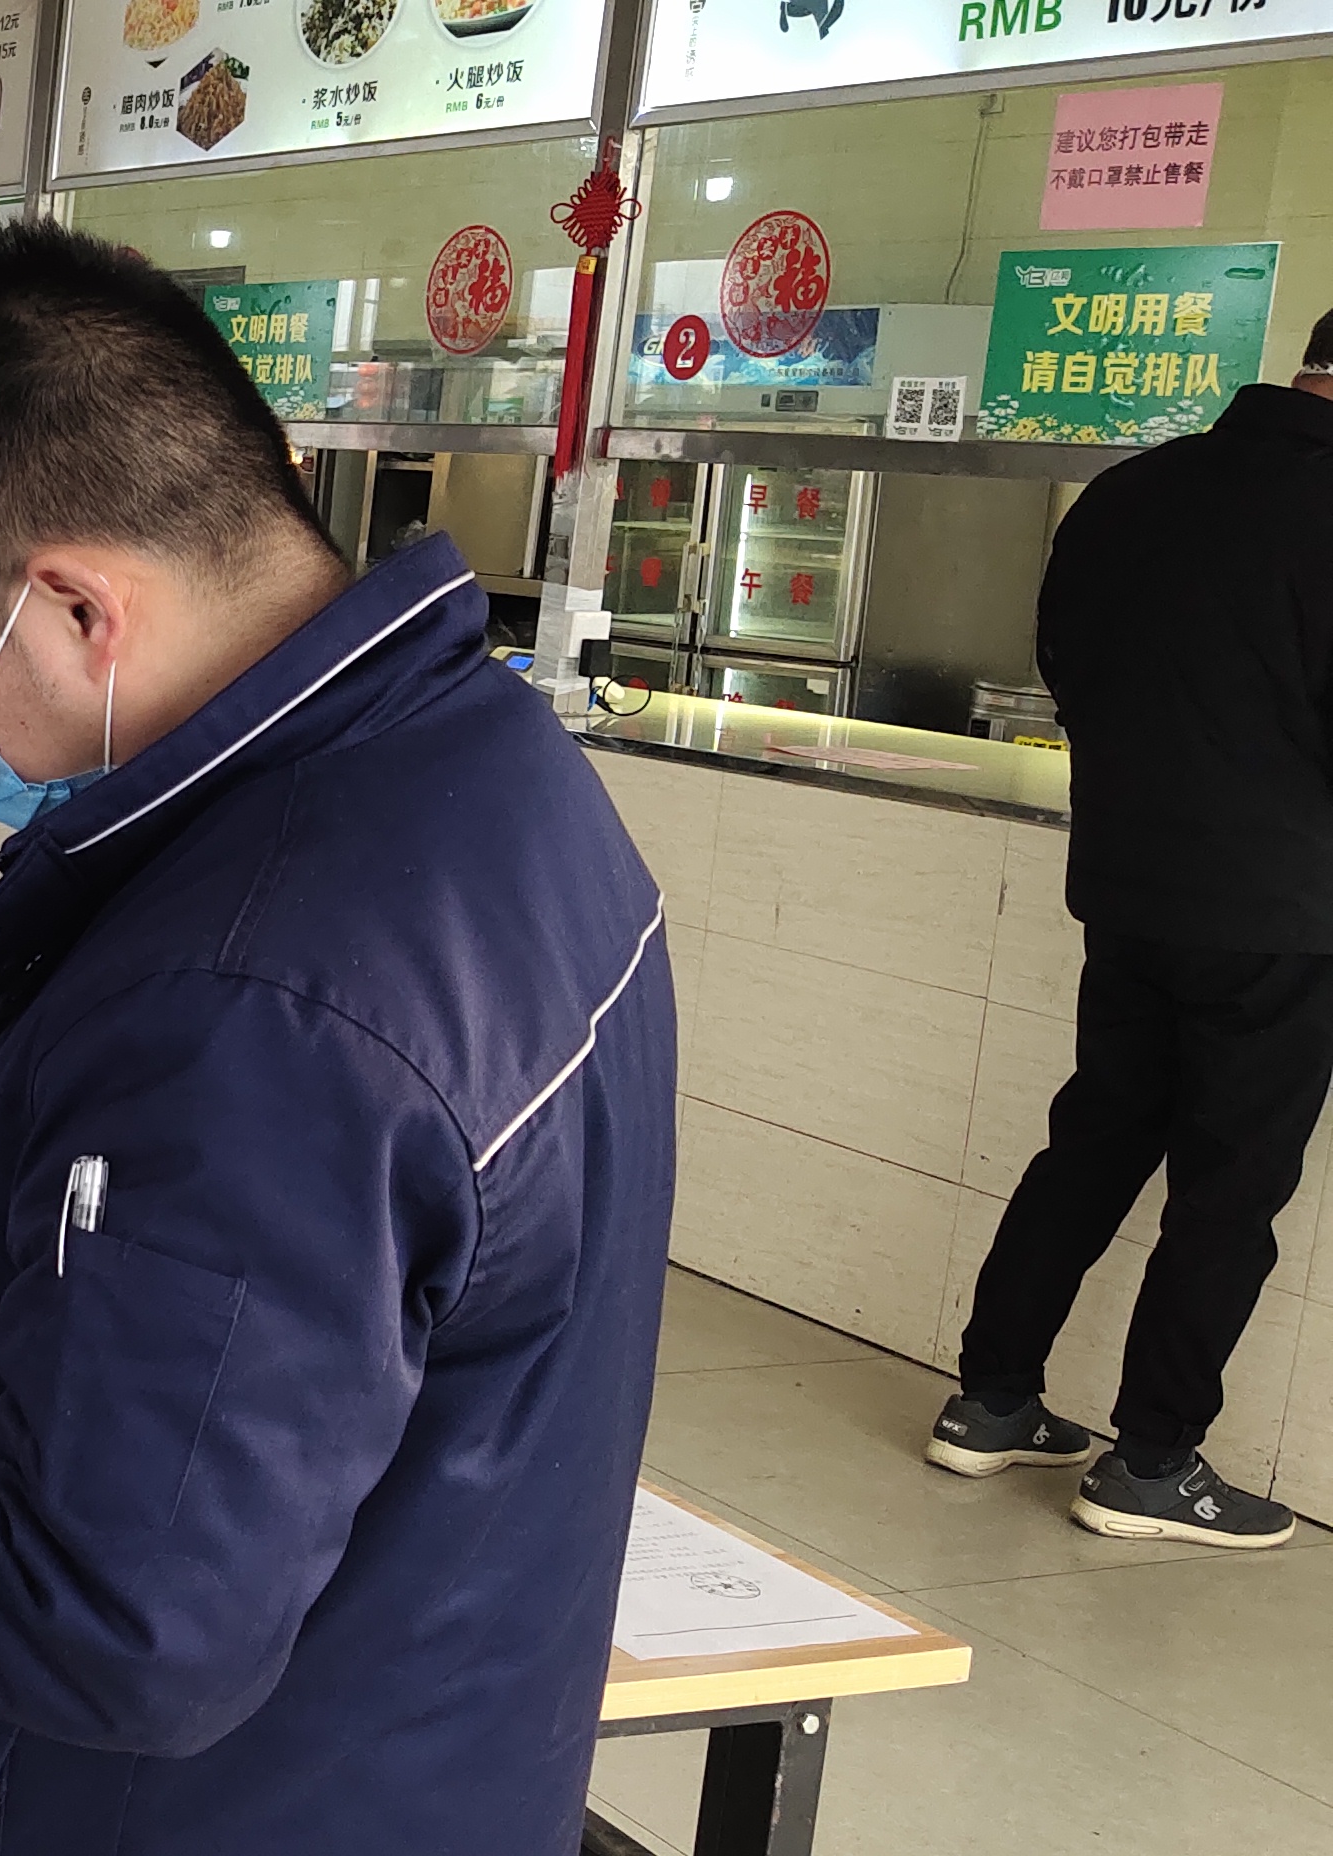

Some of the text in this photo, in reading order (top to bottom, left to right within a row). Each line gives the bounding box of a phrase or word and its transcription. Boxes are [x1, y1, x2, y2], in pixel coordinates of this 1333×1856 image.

[0, 14, 20, 31] 12元
[958, 0, 1062, 41] RMB
[446, 60, 524, 92] 火腿炒饭
[121, 88, 175, 115] 腊肉炒饭
[312, 80, 379, 110] 浆水炒饭
[446, 101, 468, 113] RMB
[1053, 120, 1211, 155] 建议您打包带走
[1050, 161, 1205, 191] 不戴口罩禁止售餐
[774, 248, 824, 313] 福
[228, 313, 309, 347] 文明用餐
[1047, 292, 1214, 337] 文明用餐
[675, 327, 697, 369] 2
[1021, 350, 1221, 397] 请自觉排队
